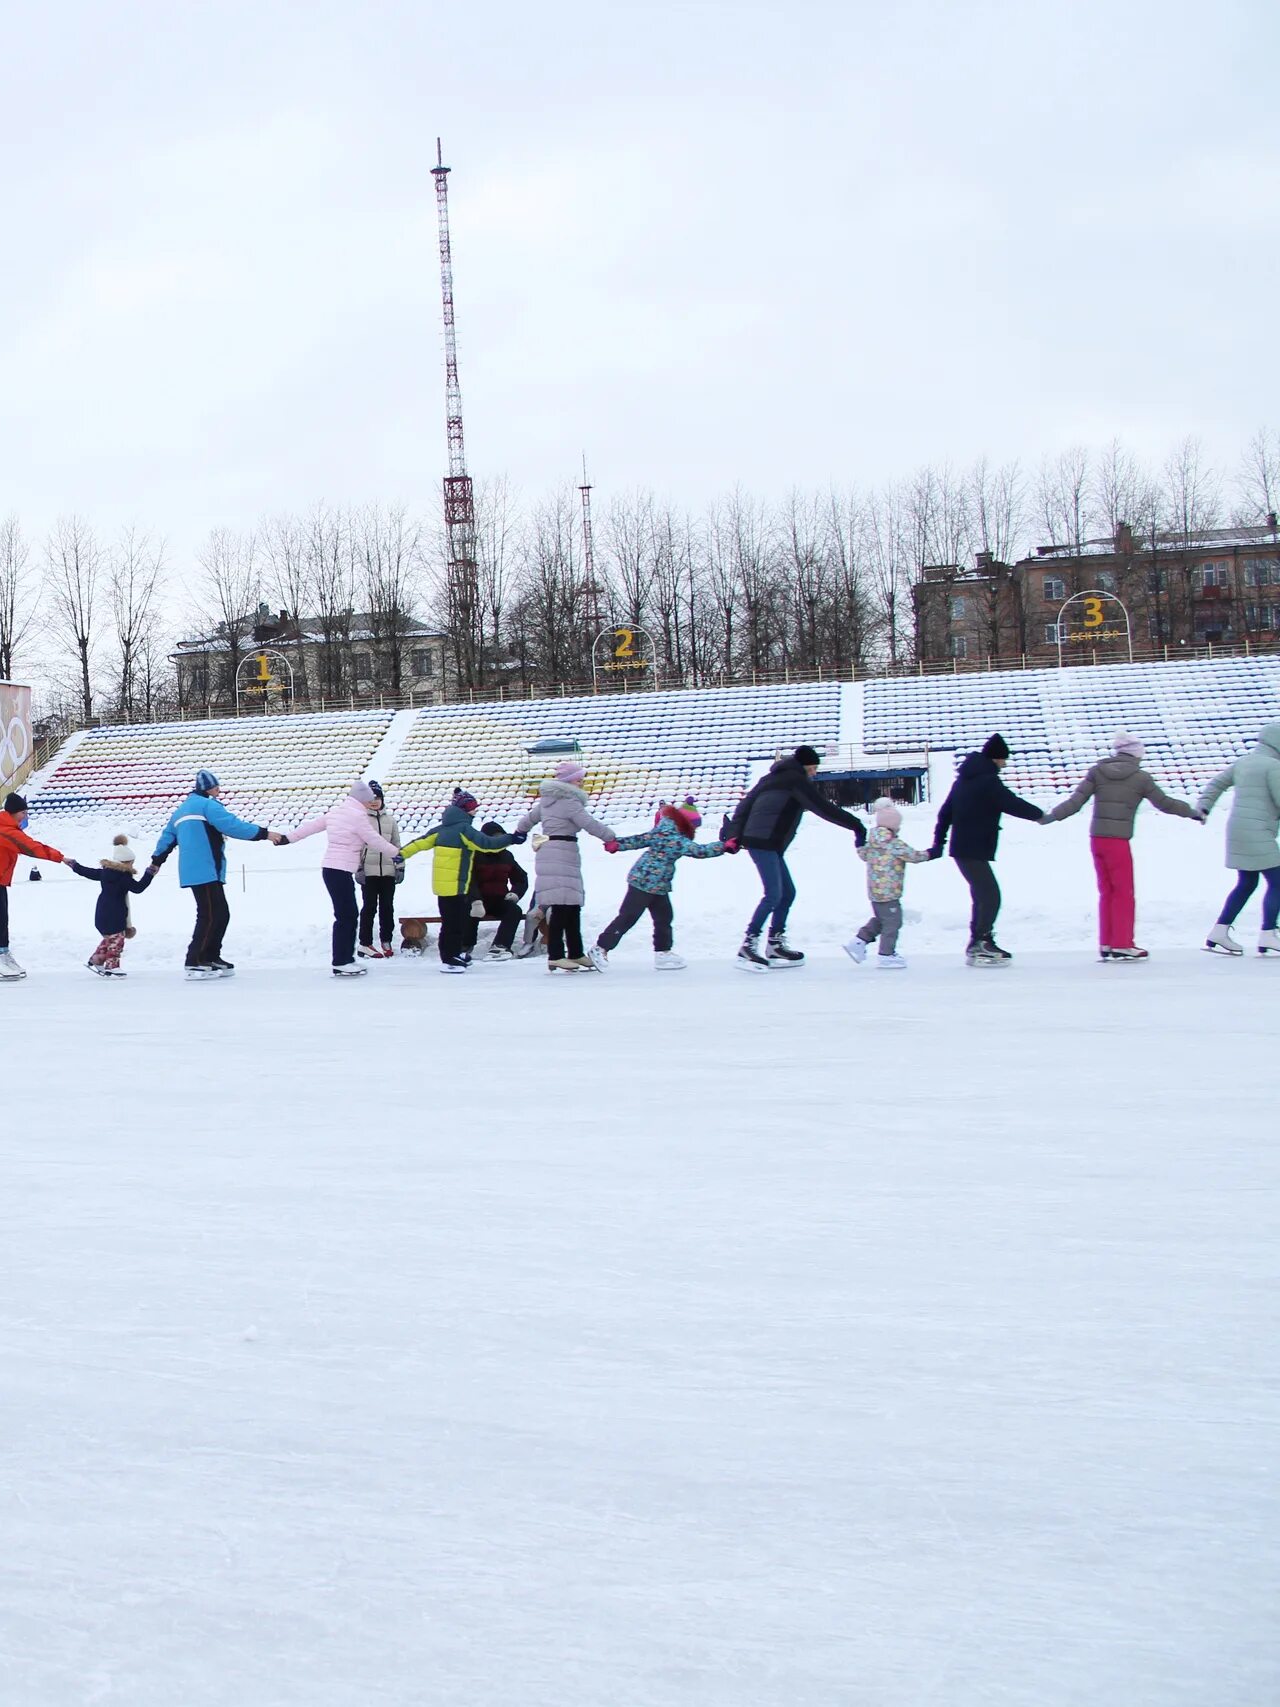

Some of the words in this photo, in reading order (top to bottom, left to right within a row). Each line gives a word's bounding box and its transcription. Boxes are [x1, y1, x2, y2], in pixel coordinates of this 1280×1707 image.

[1084, 597, 1104, 627] 3
[615, 628, 633, 657] 2
[1070, 630, 1119, 640] СЕКТОР
[255, 655, 272, 680] 1
[604, 660, 648, 671] СЕКТОР
